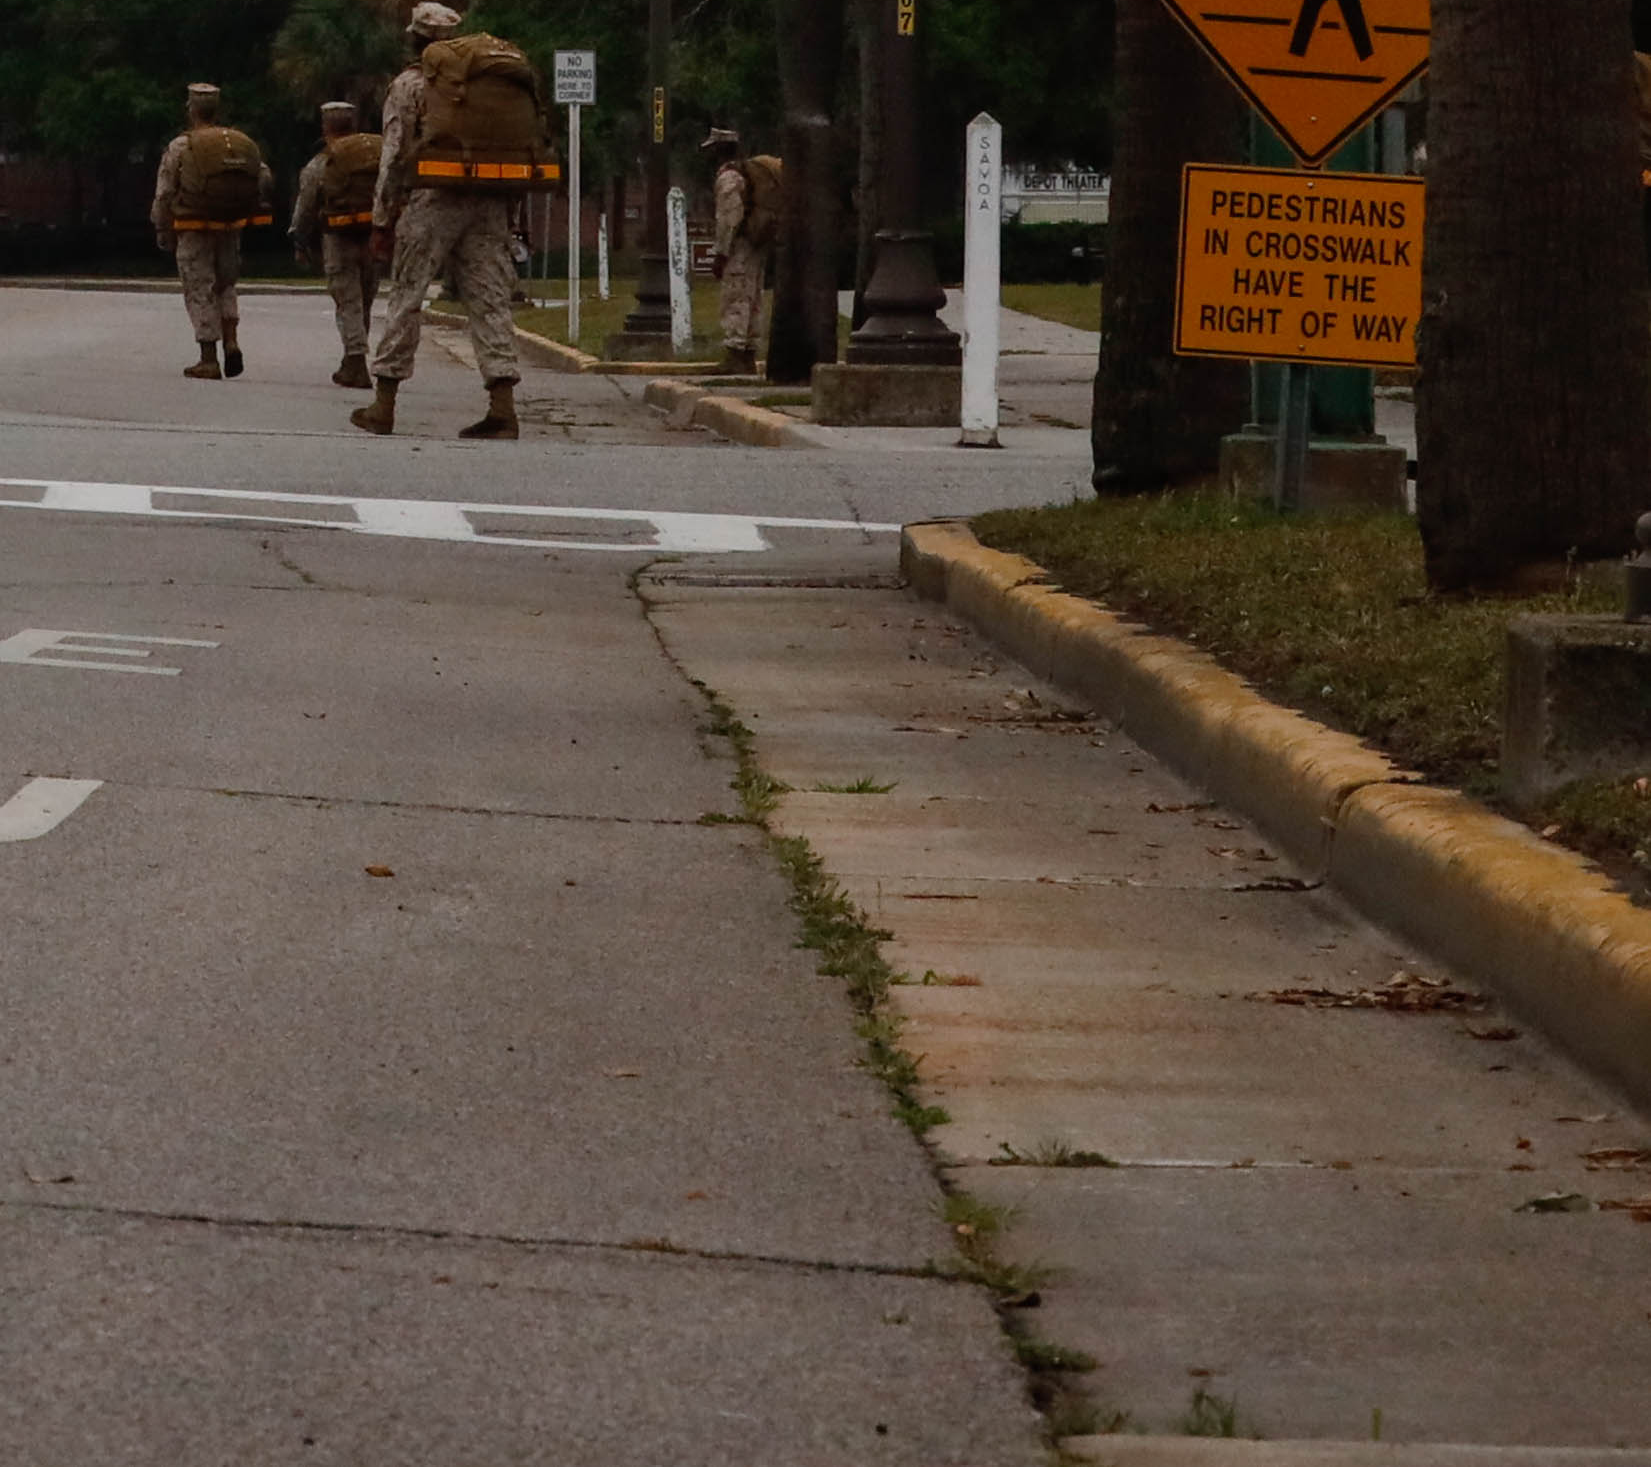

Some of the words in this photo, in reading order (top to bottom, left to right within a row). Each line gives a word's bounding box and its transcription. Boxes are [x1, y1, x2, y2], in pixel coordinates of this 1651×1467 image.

[557, 69, 593, 79] PARKING
[567, 56, 582, 66] NO
[1024, 175, 1057, 189] DEPOT
[1062, 175, 1104, 189] THEATER
[1211, 190, 1406, 230] PEDESTRIANS
[1204, 228, 1229, 256] IN
[1246, 230, 1411, 267] CROSSWALK
[1233, 267, 1304, 299] HAVE
[1324, 273, 1377, 304] THE
[1200, 304, 1283, 336] RIGHT
[1300, 310, 1338, 339] OF
[1352, 315, 1408, 344] WAY
